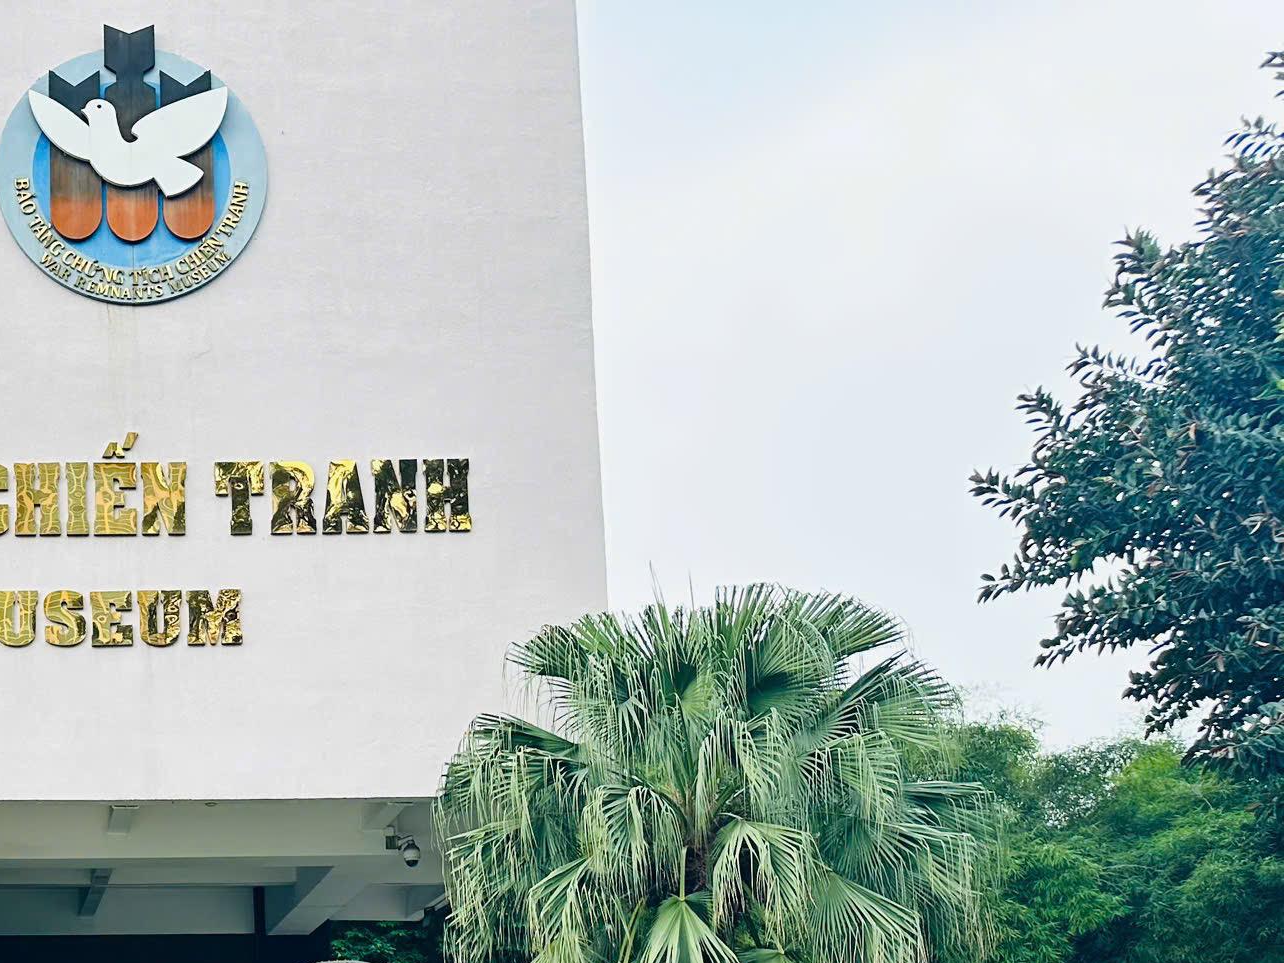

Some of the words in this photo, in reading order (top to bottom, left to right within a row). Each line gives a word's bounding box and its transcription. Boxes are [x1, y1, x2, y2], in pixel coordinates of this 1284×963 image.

[28, 215, 66, 257] TÀNG
[129, 265, 175, 286] TÍCH
[216, 180, 250, 238] TRANH
[40, 252, 72, 282] WAR
[74, 275, 164, 300] REMNANTS
[168, 252, 231, 294] MUSEUM
[214, 458, 473, 536] TRANH
